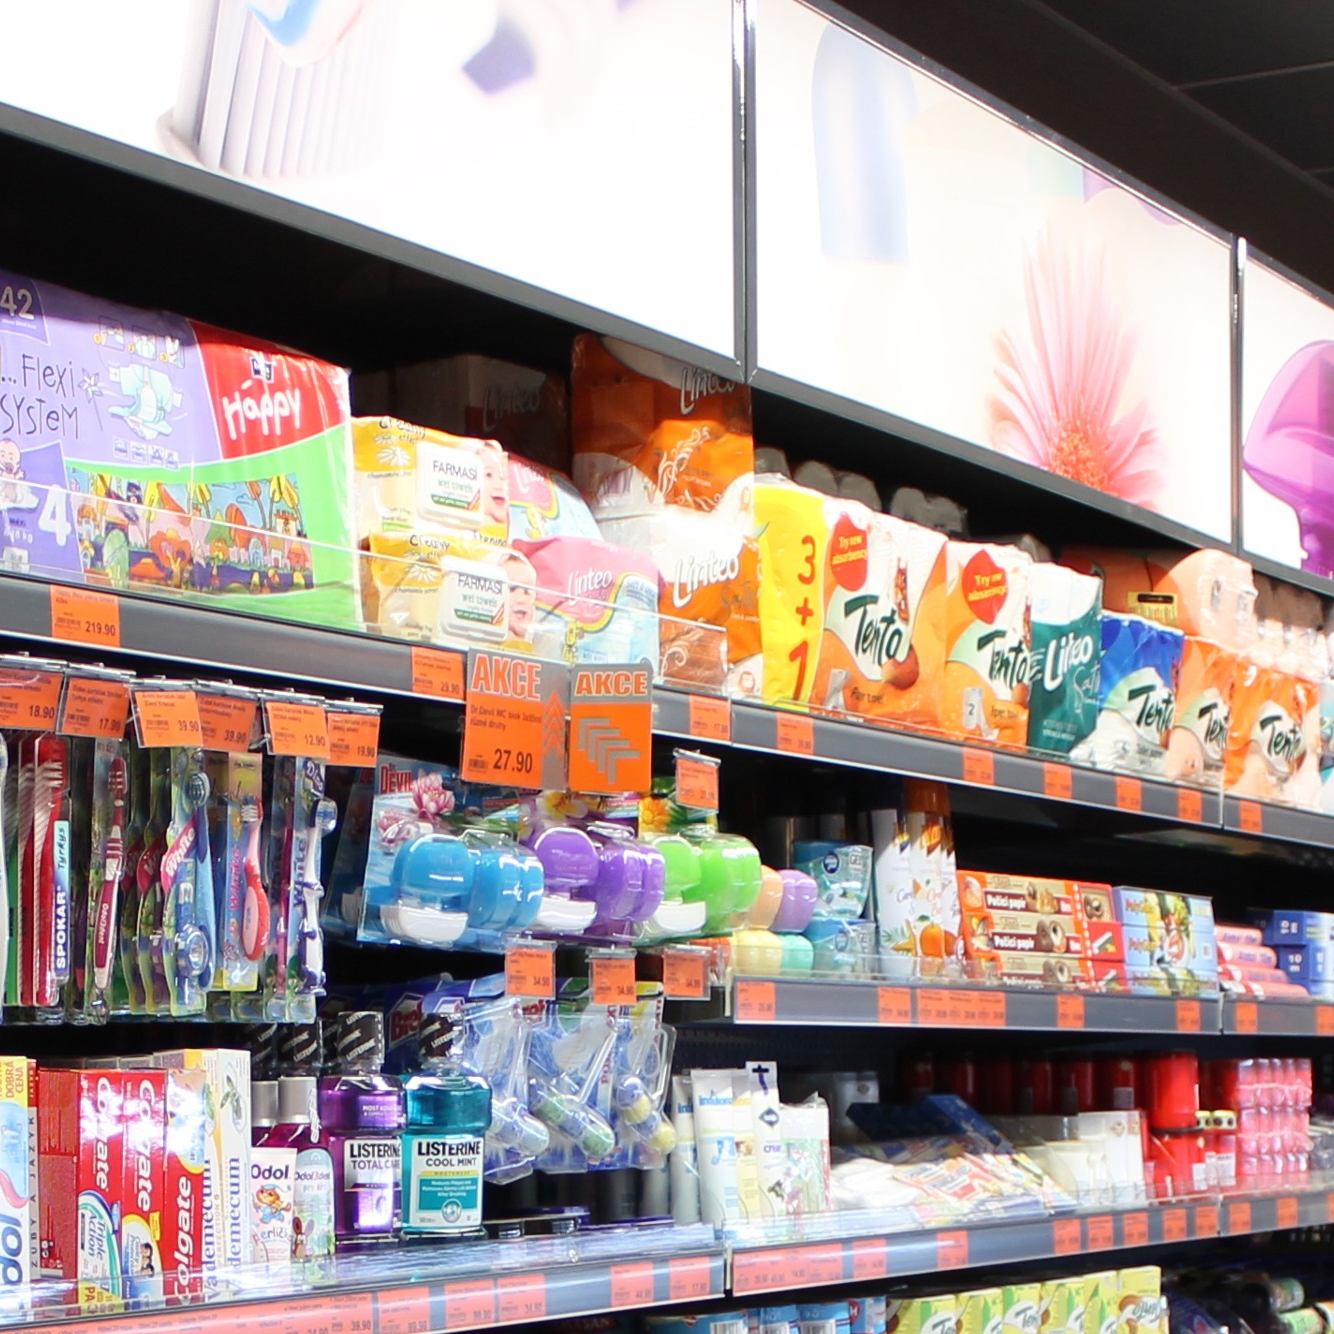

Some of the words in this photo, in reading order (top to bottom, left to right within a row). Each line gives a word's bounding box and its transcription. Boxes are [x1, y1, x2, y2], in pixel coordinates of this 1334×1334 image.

[0, 286, 35, 321] 42
[22, 353, 75, 397] Flexi
[37, 485, 71, 547] 4
[797, 535, 816, 584] 3
[673, 548, 740, 608] Linteo
[844, 594, 902, 661] Tento
[471, 653, 542, 701] AKCE
[575, 671, 648, 696] AKCE
[29, 704, 55, 720] 18.90
[178, 720, 199, 733] 39.90
[224, 730, 247, 744] 39.90
[494, 748, 533, 775] 27.90
[380, 769, 414, 795] DEVIL
[55, 890, 67, 969] SPOKAR
[417, 1141, 481, 1156] LISTERINE
[426, 1158, 454, 1167] COOL
[457, 1157, 476, 1166] MINT
